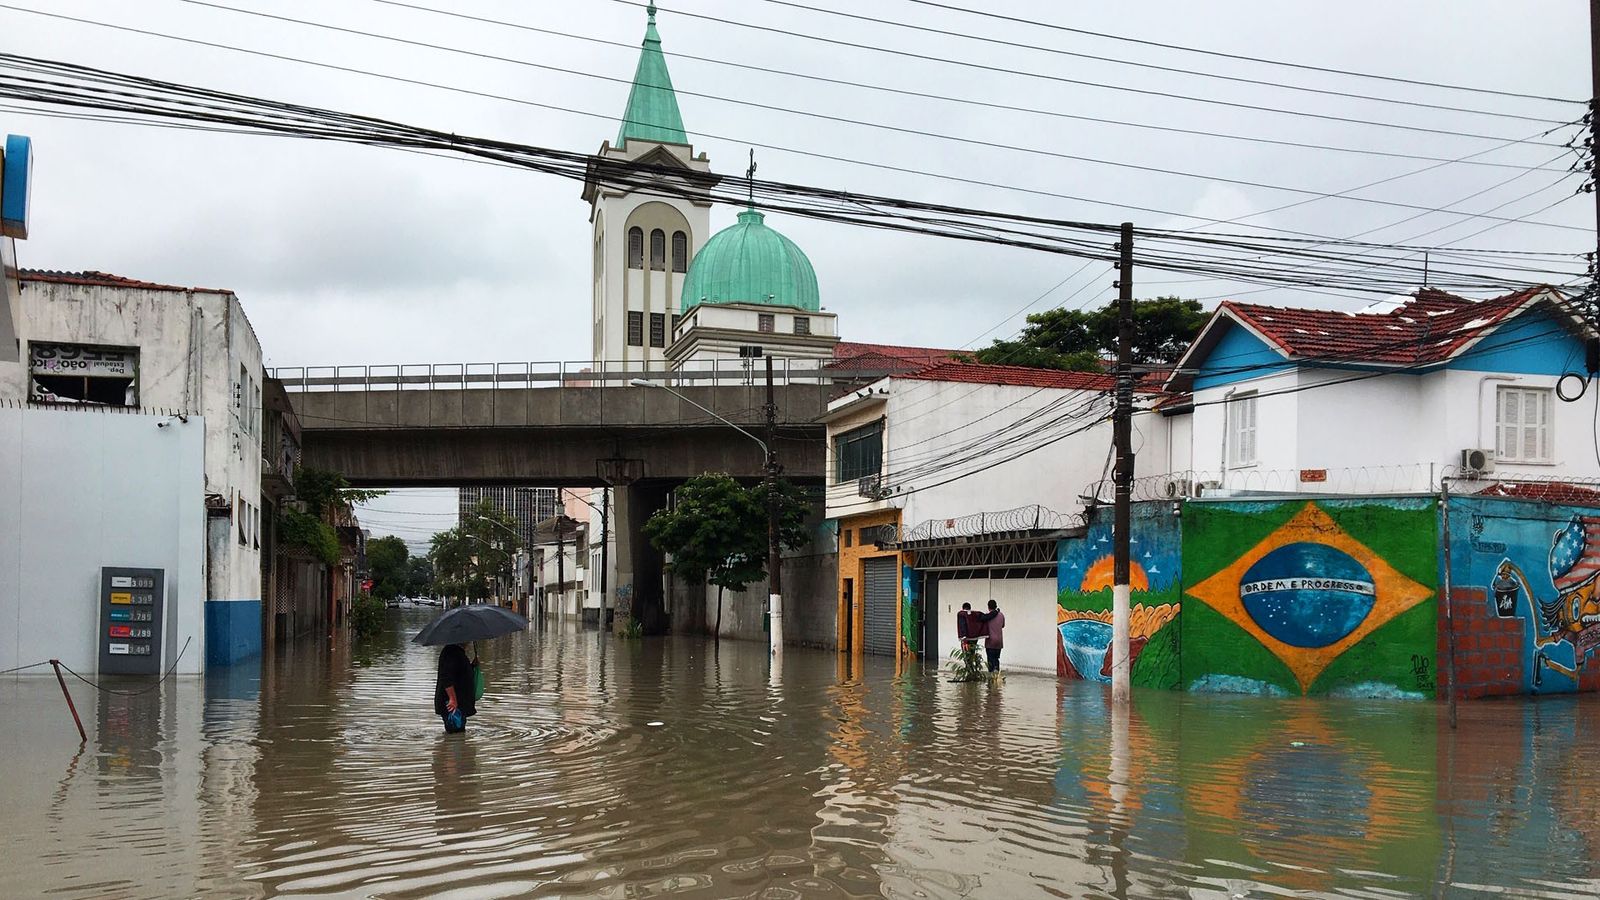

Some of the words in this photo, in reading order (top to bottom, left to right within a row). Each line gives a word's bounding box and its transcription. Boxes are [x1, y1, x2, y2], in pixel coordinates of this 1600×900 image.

[1245, 581, 1286, 593] ORDEM
[1291, 580, 1297, 588] E
[1302, 580, 1363, 591] PROGRESSO
